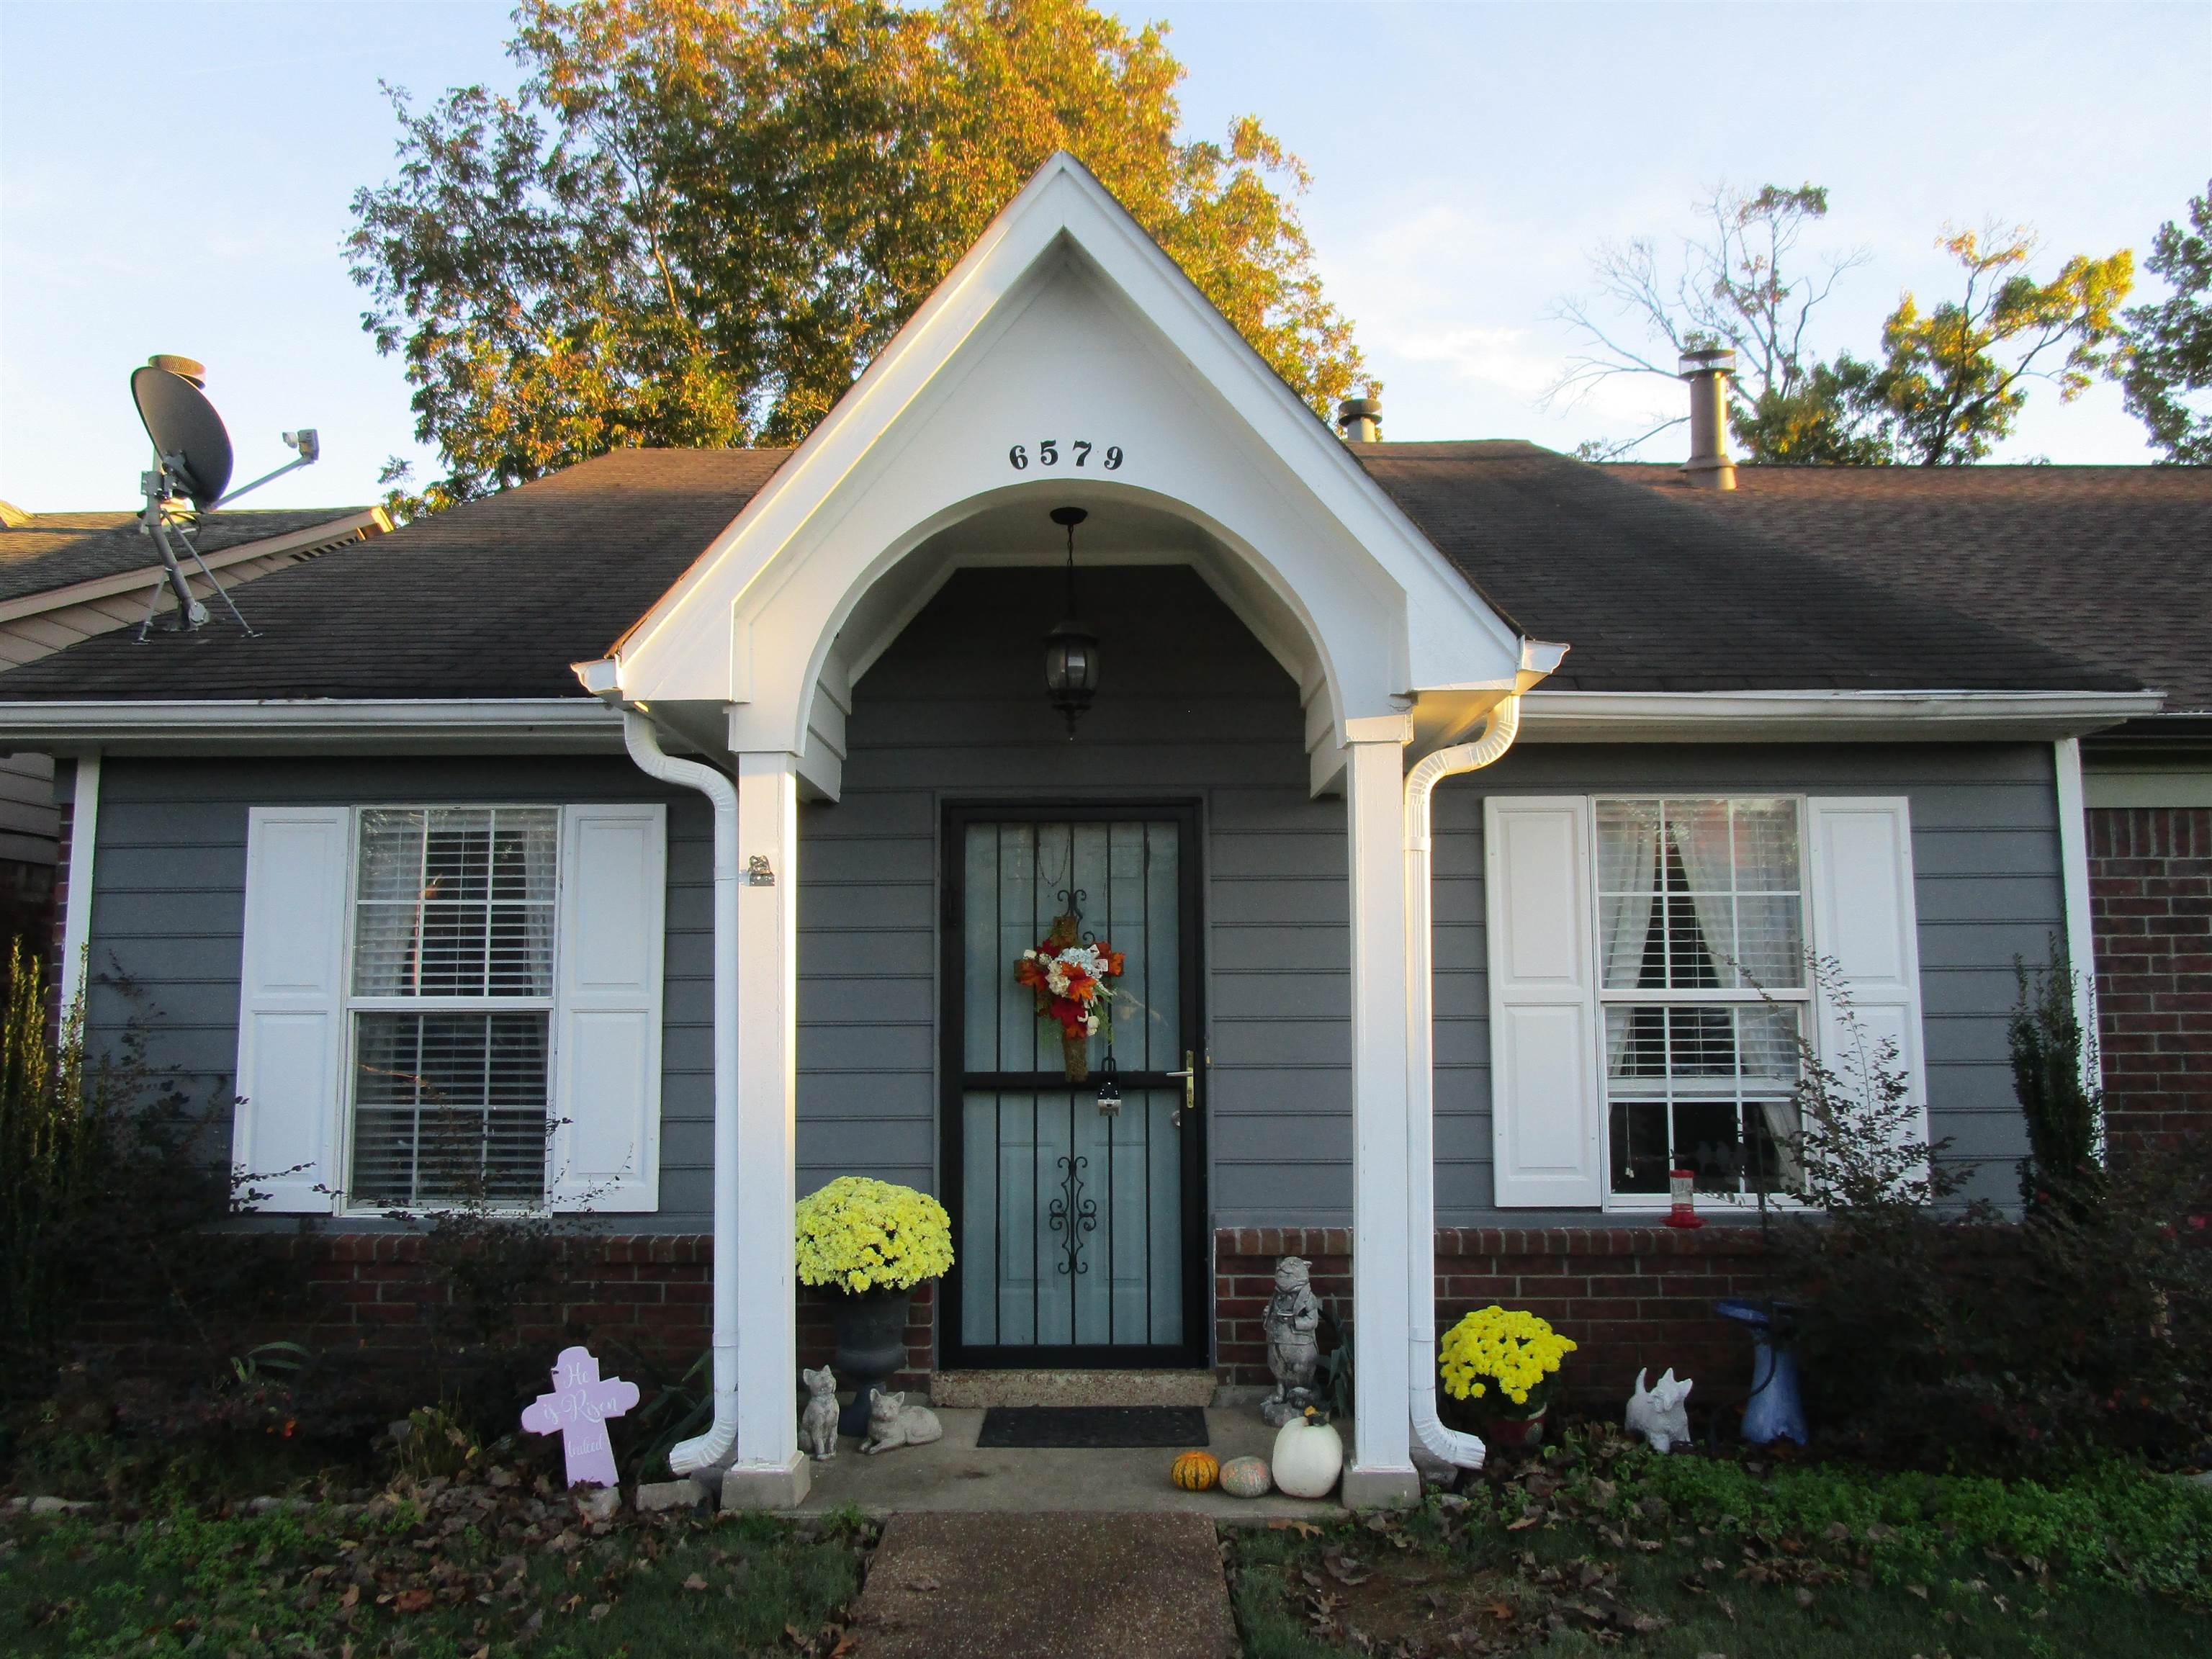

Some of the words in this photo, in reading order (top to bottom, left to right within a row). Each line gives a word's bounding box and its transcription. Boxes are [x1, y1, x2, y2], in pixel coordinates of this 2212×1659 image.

[1010, 440, 1123, 470] 6579
[563, 1362, 588, 1388] He
[544, 1403, 558, 1425] is
[561, 1389, 617, 1423] Risen
